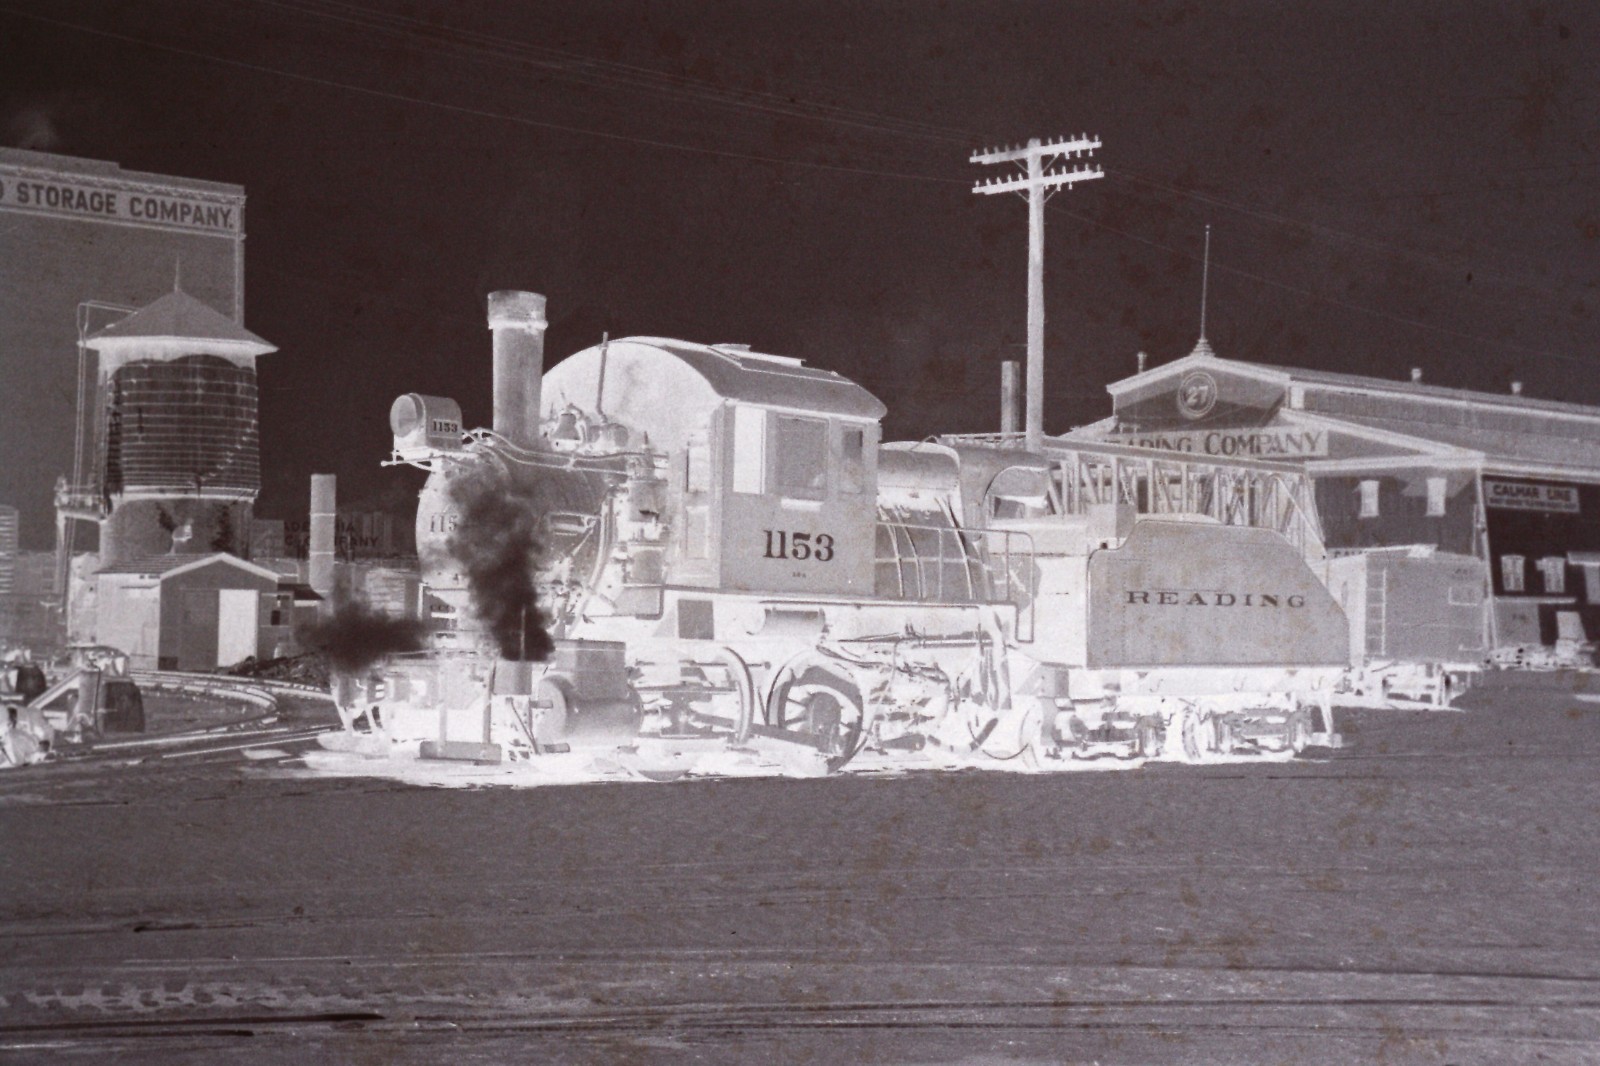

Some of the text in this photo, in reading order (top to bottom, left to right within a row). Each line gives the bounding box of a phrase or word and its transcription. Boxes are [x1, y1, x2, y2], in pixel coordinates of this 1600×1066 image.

[16, 182, 118, 214] STORAGE
[1187, 385, 1209, 405] 27
[432, 421, 458, 432] 1153
[1204, 432, 1322, 456] COMPANY
[429, 514, 459, 533] 115
[762, 529, 835, 562] 1153
[1126, 590, 1305, 608] READING
